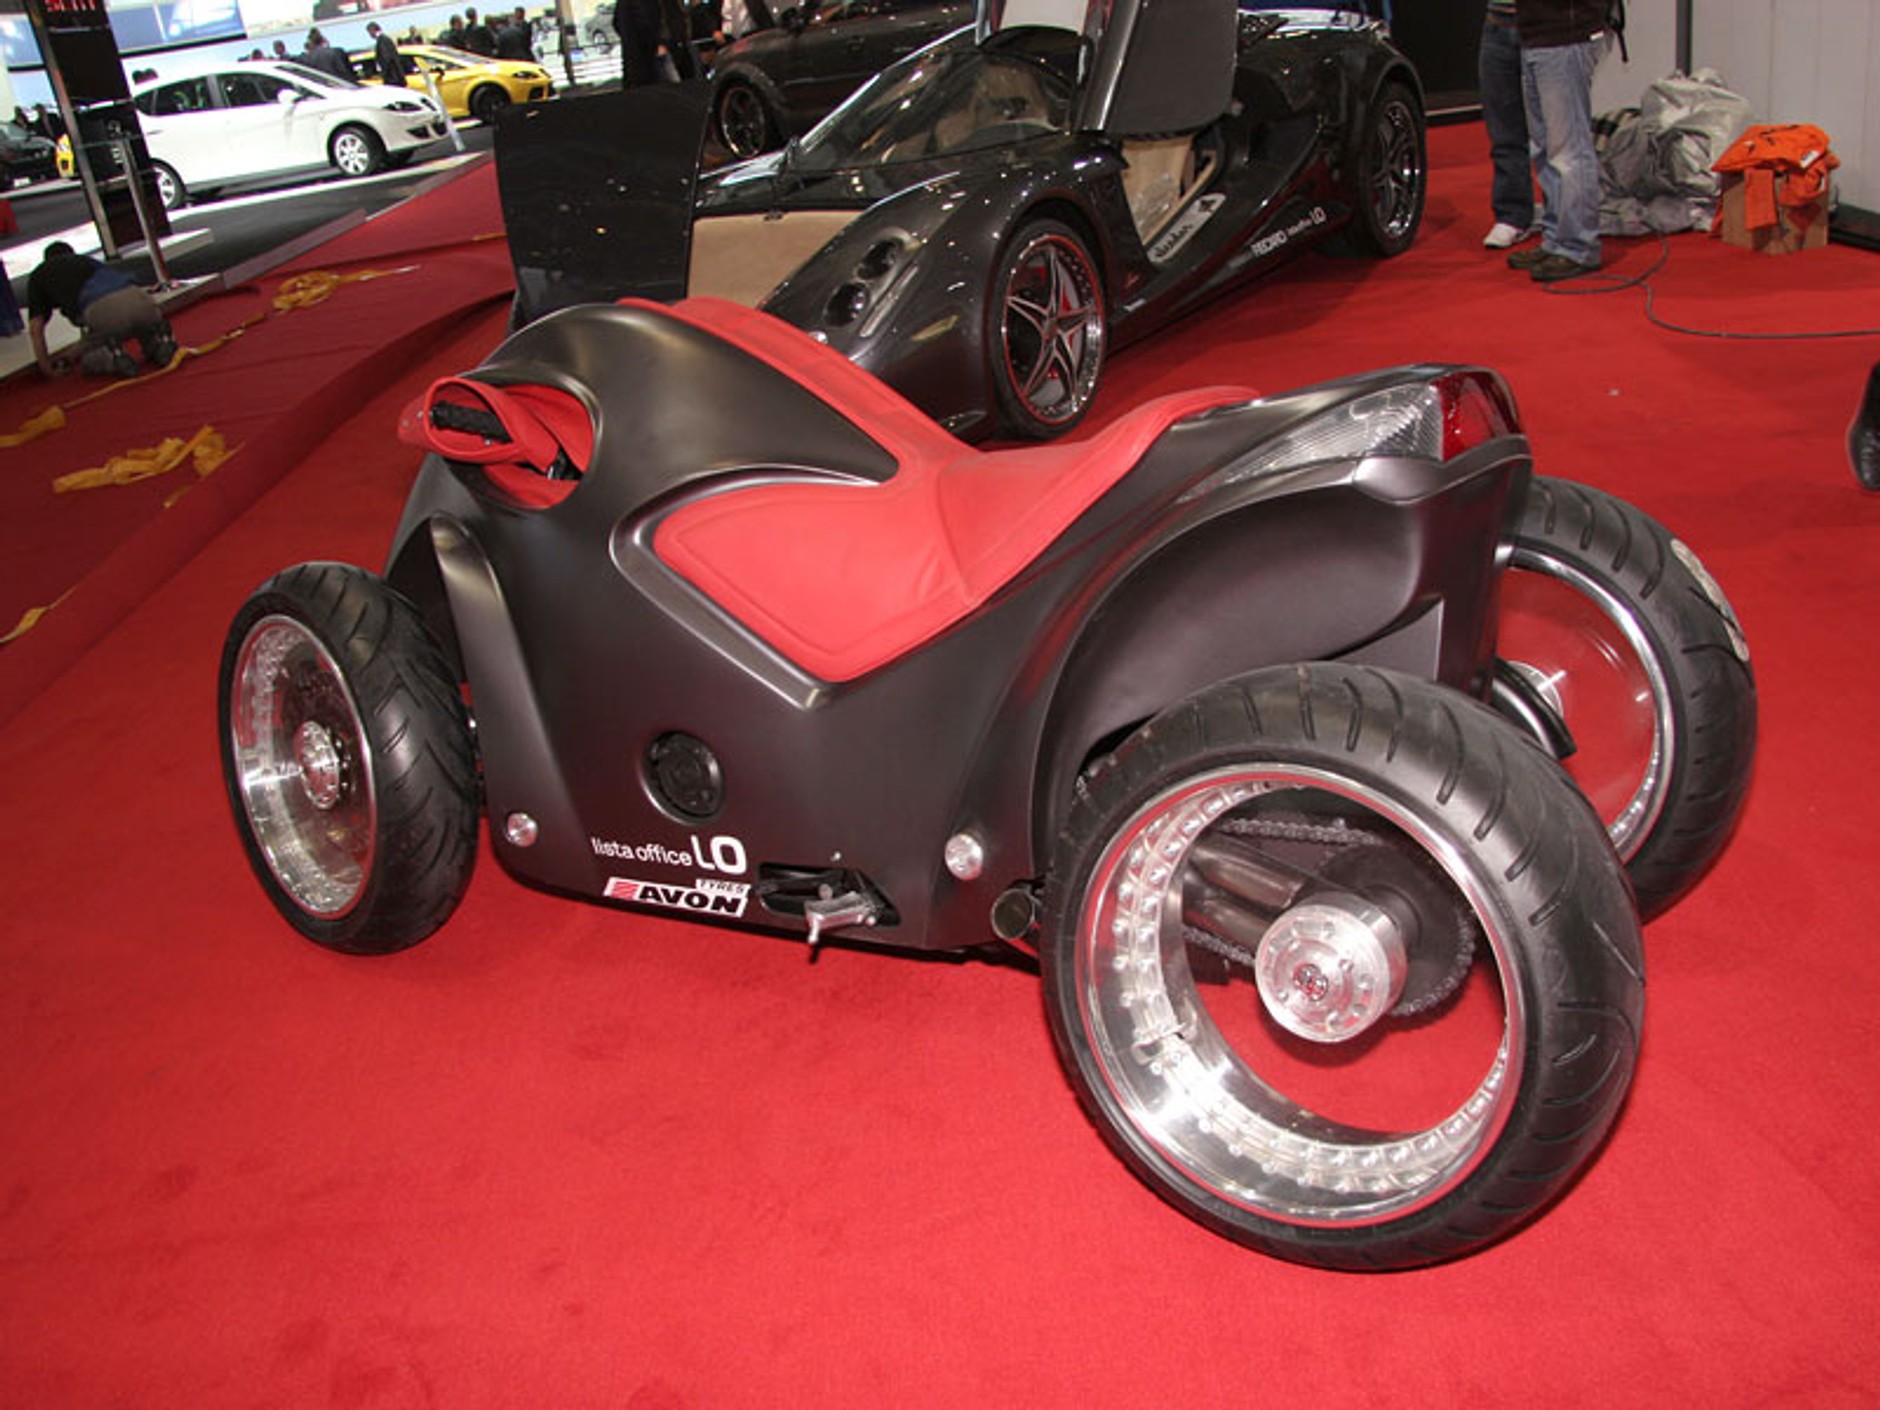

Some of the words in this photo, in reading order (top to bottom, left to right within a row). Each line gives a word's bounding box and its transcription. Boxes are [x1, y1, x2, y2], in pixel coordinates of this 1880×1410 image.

[591, 837, 635, 860] lista
[636, 844, 691, 866] office
[691, 835, 747, 874] LO
[639, 886, 742, 914] AVON
[699, 880, 746, 893] TYRES
